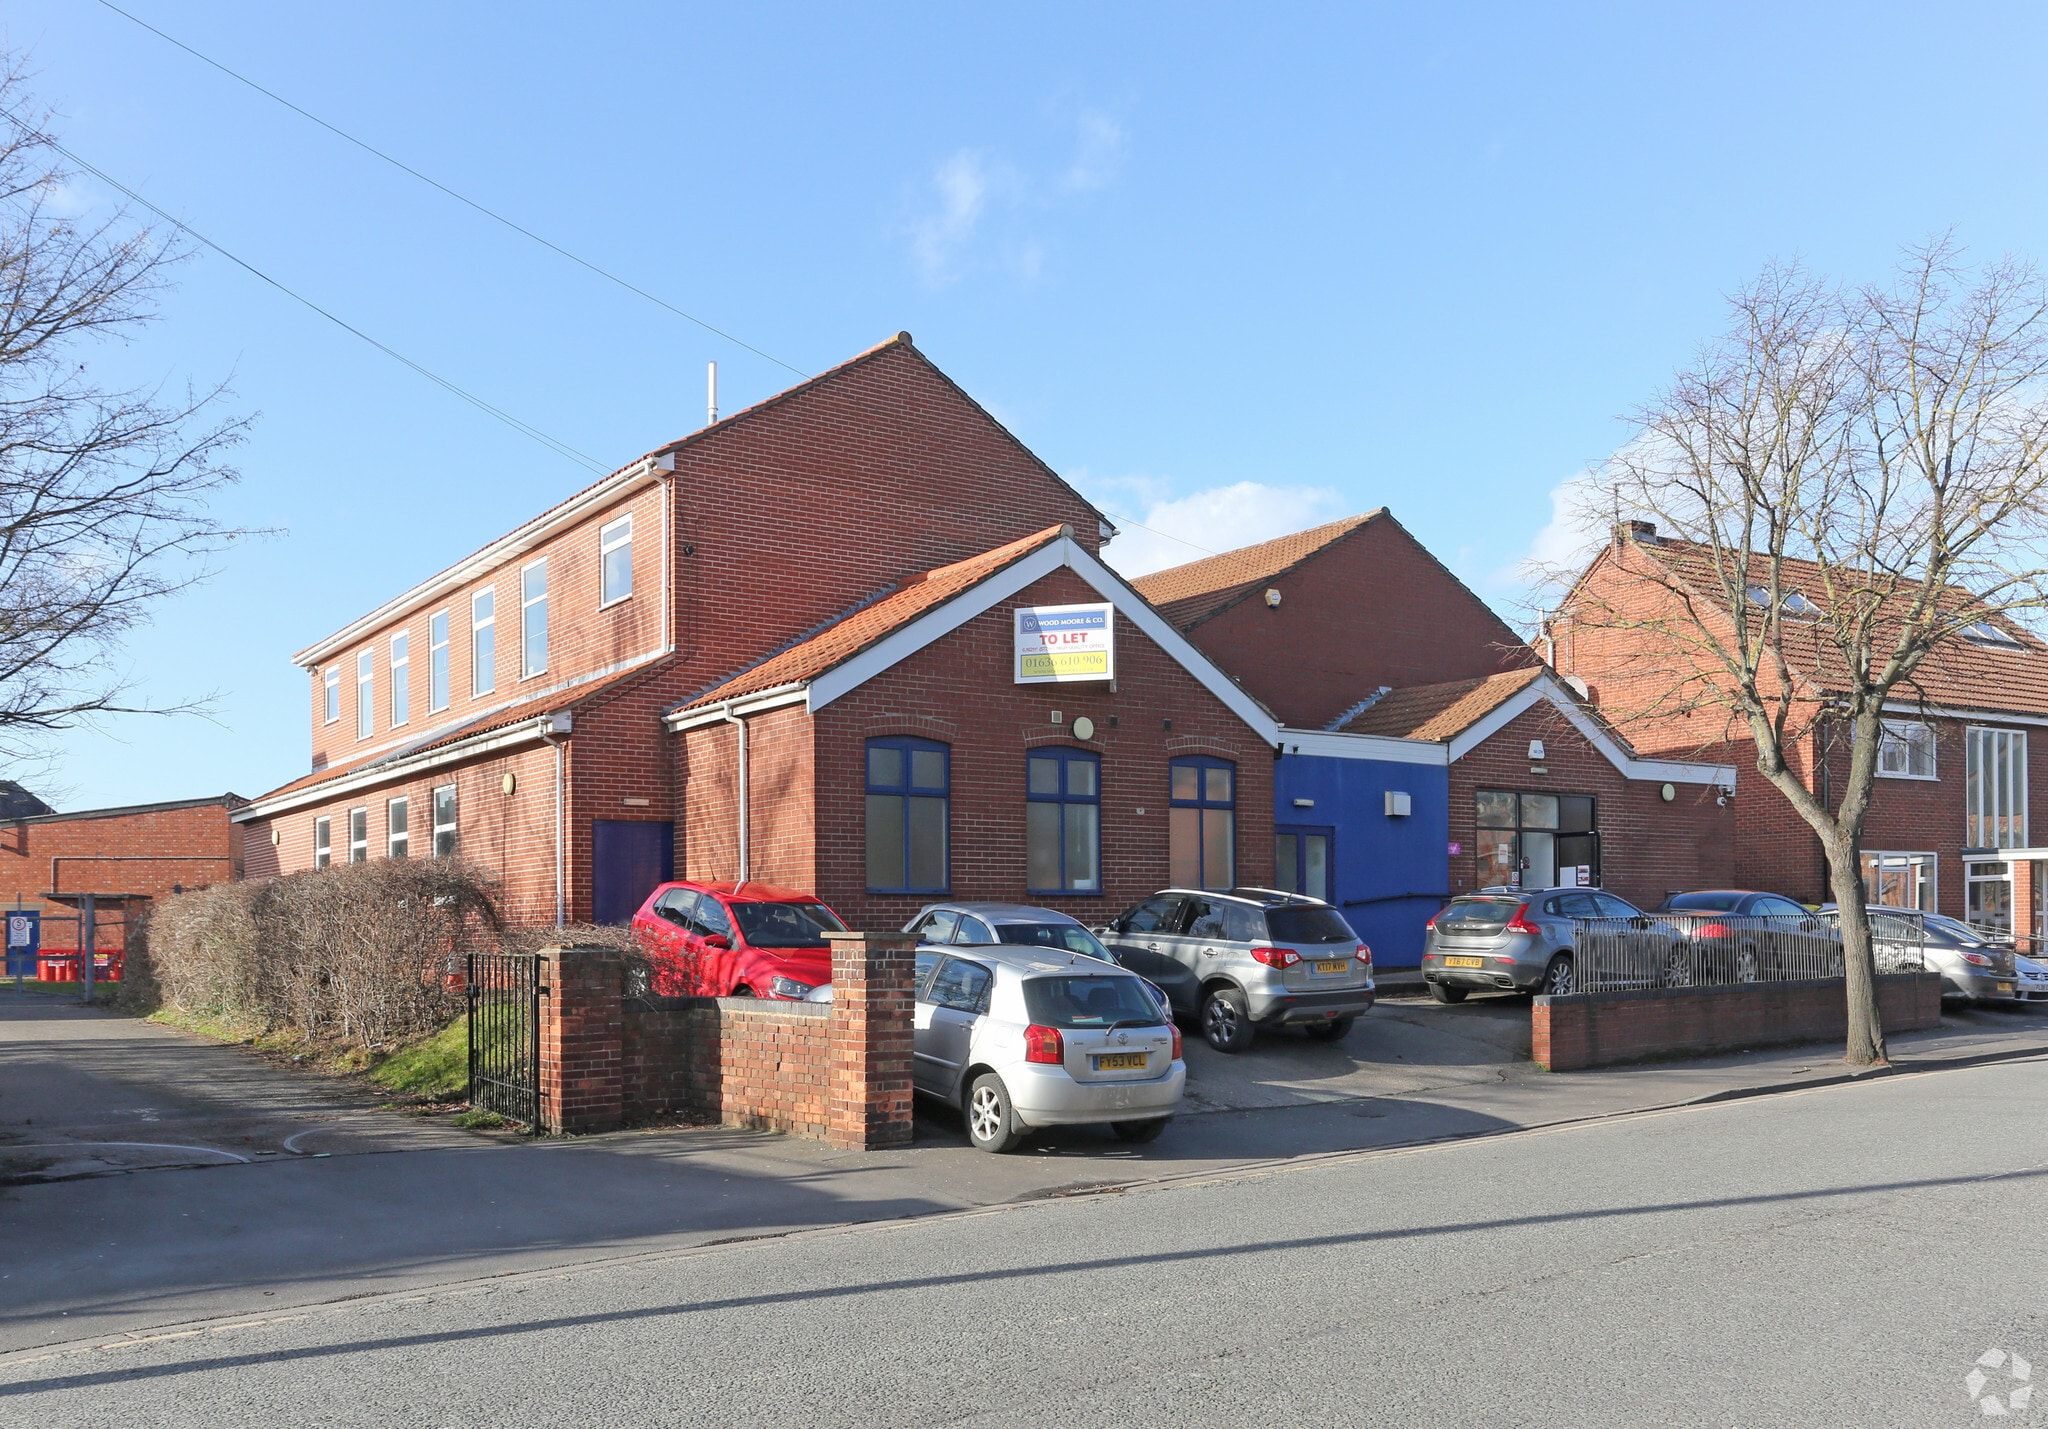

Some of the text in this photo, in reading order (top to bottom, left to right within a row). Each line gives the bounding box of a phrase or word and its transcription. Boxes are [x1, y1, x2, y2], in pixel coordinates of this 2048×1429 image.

[1039, 633, 1088, 645] TO LET
[1026, 655, 1102, 668] 01636 610 906
[1100, 1055, 1145, 1067] FY53 VCL
